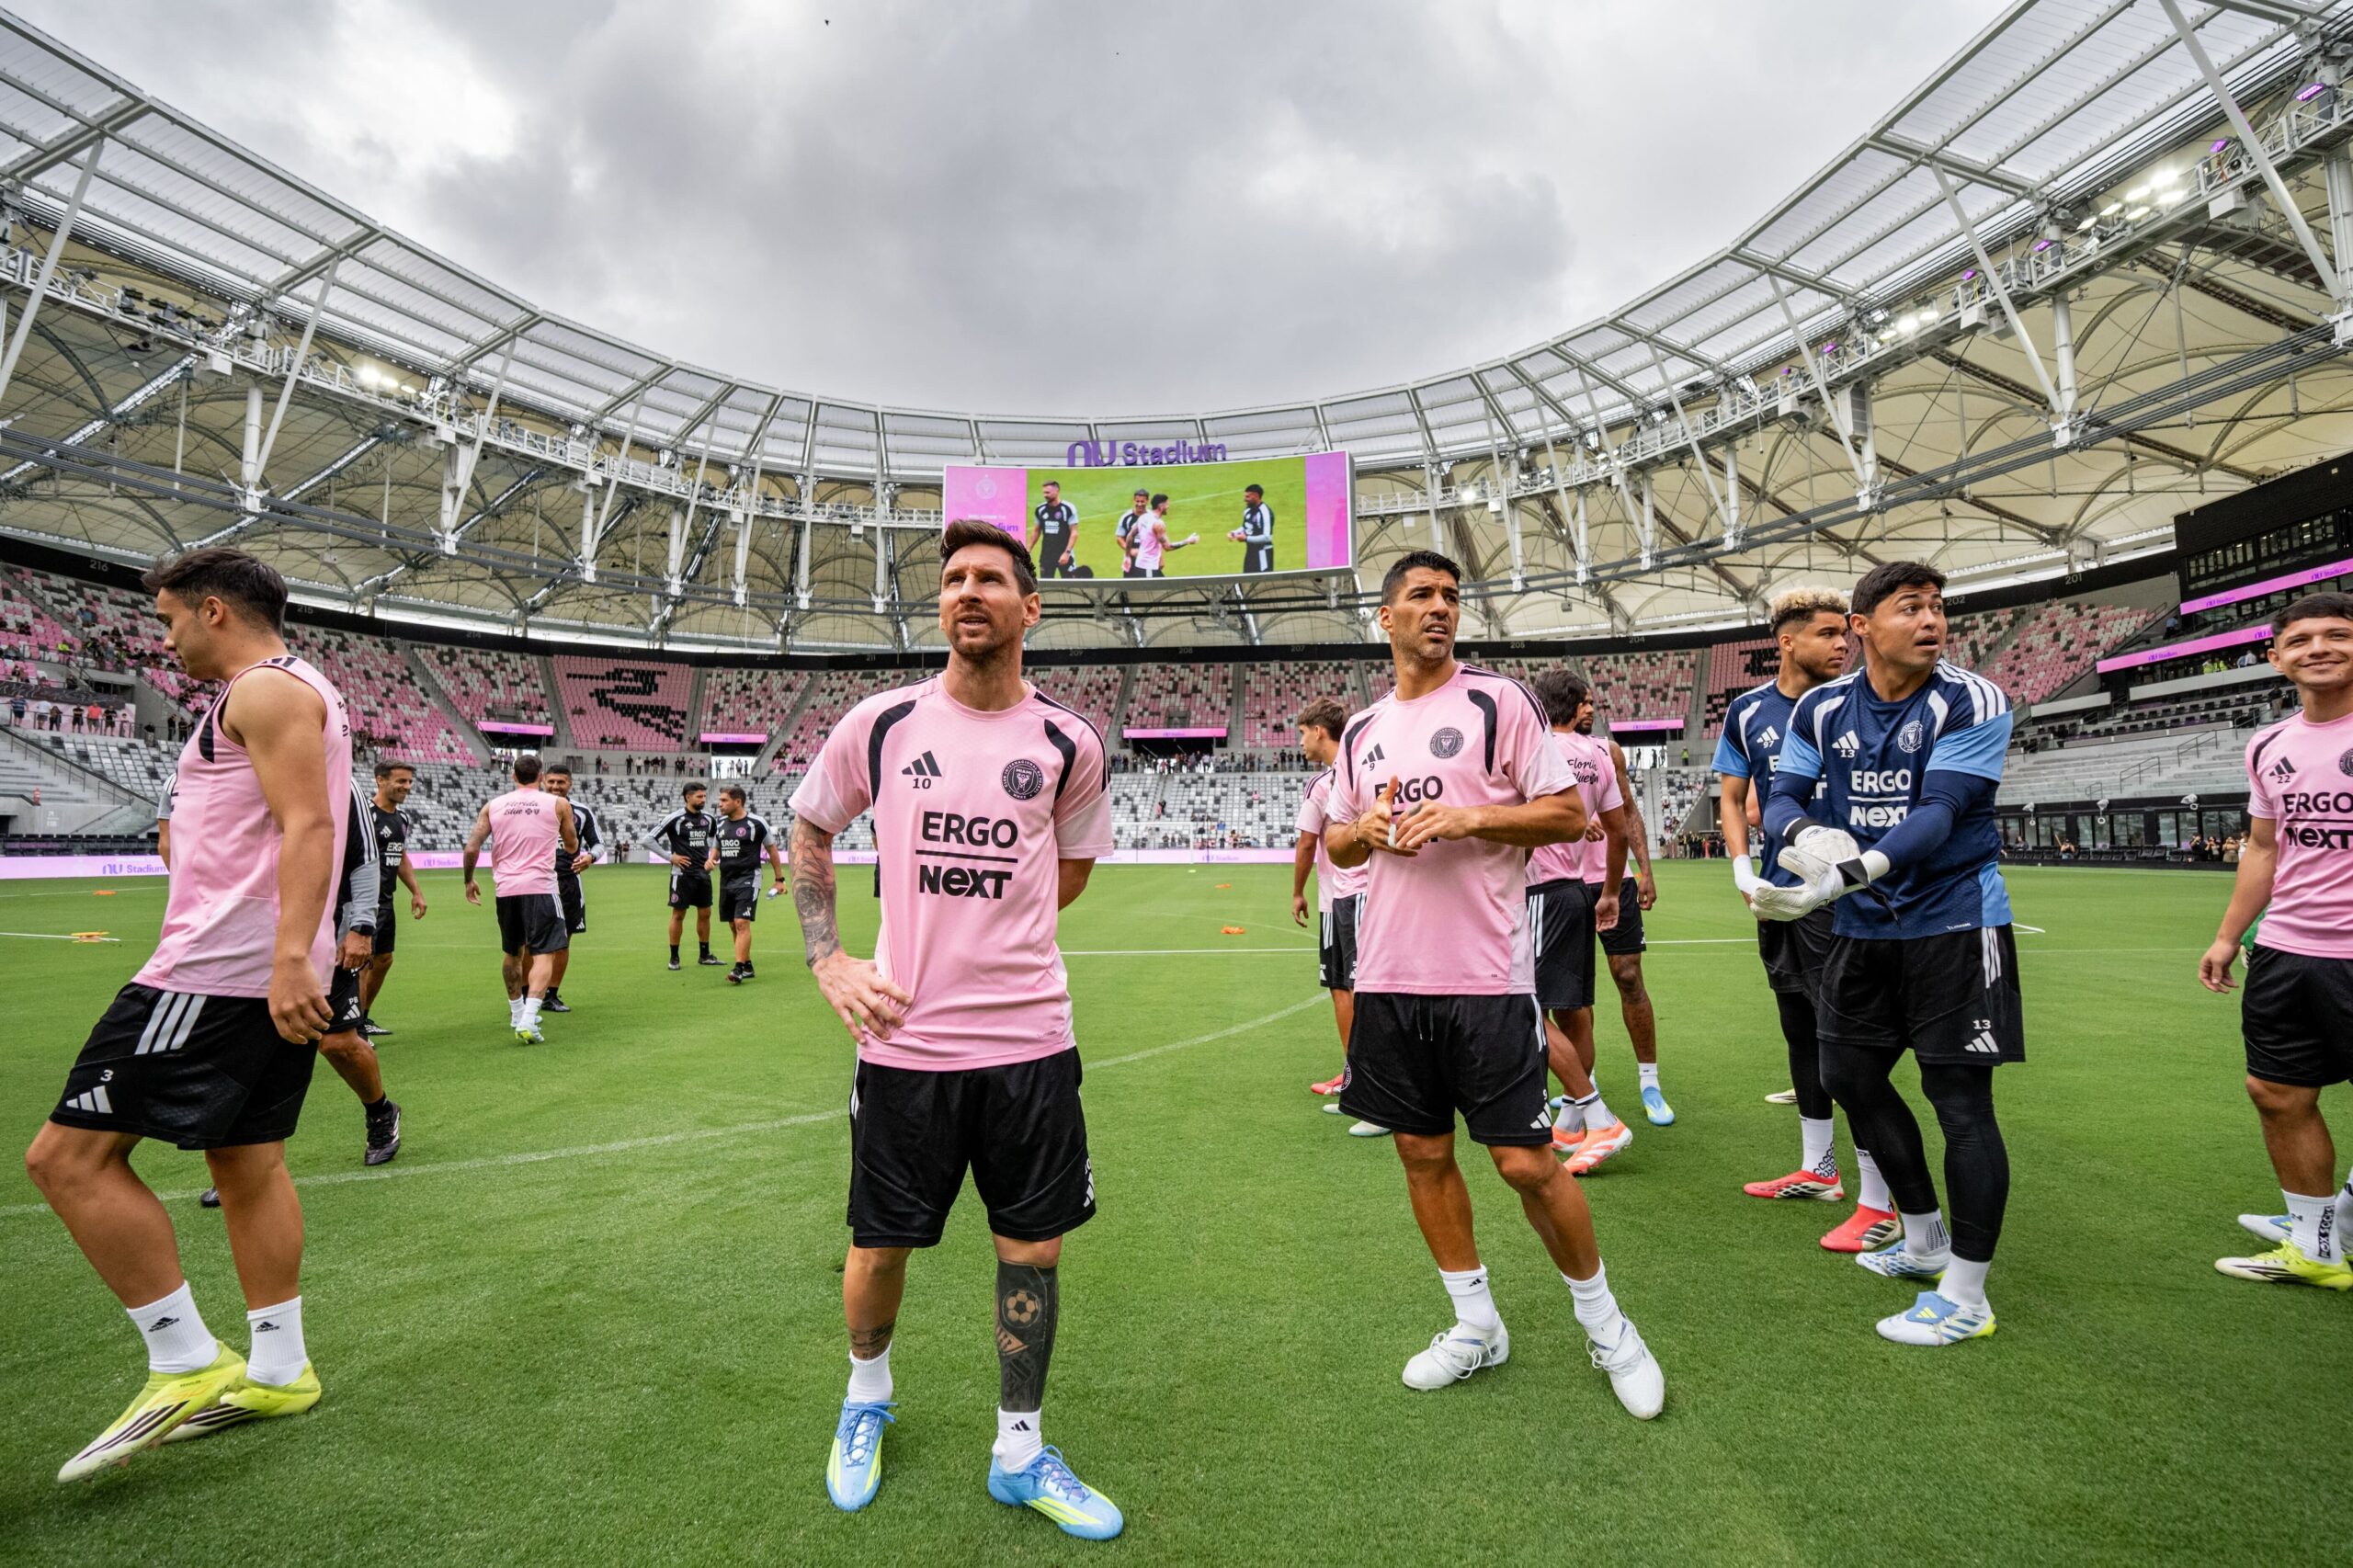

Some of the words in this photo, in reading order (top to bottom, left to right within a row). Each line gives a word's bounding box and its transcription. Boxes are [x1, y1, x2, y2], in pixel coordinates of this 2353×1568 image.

[1122, 440, 1226, 466] Stadium
[89, 559, 108, 572] 216
[2065, 573, 2082, 585] 201
[1946, 596, 1965, 607] 202
[297, 605, 313, 615] 215
[1629, 636, 1645, 644] 204
[1510, 642, 1525, 650] 205
[1763, 740, 1775, 749] 97
[1840, 749, 1856, 758] 13
[1370, 762, 1376, 771] 9
[1573, 771, 1589, 783] lue
[1851, 768, 1912, 793] ERGO
[2277, 775, 2290, 784] 22
[913, 778, 932, 790] 10
[2282, 791, 2353, 814] ERGO
[922, 811, 1018, 849] ERGO
[721, 839, 740, 847] ERGO
[126, 863, 166, 874] Stadium
[1972, 1018, 1992, 1030] 13
[100, 1069, 114, 1082] 3
